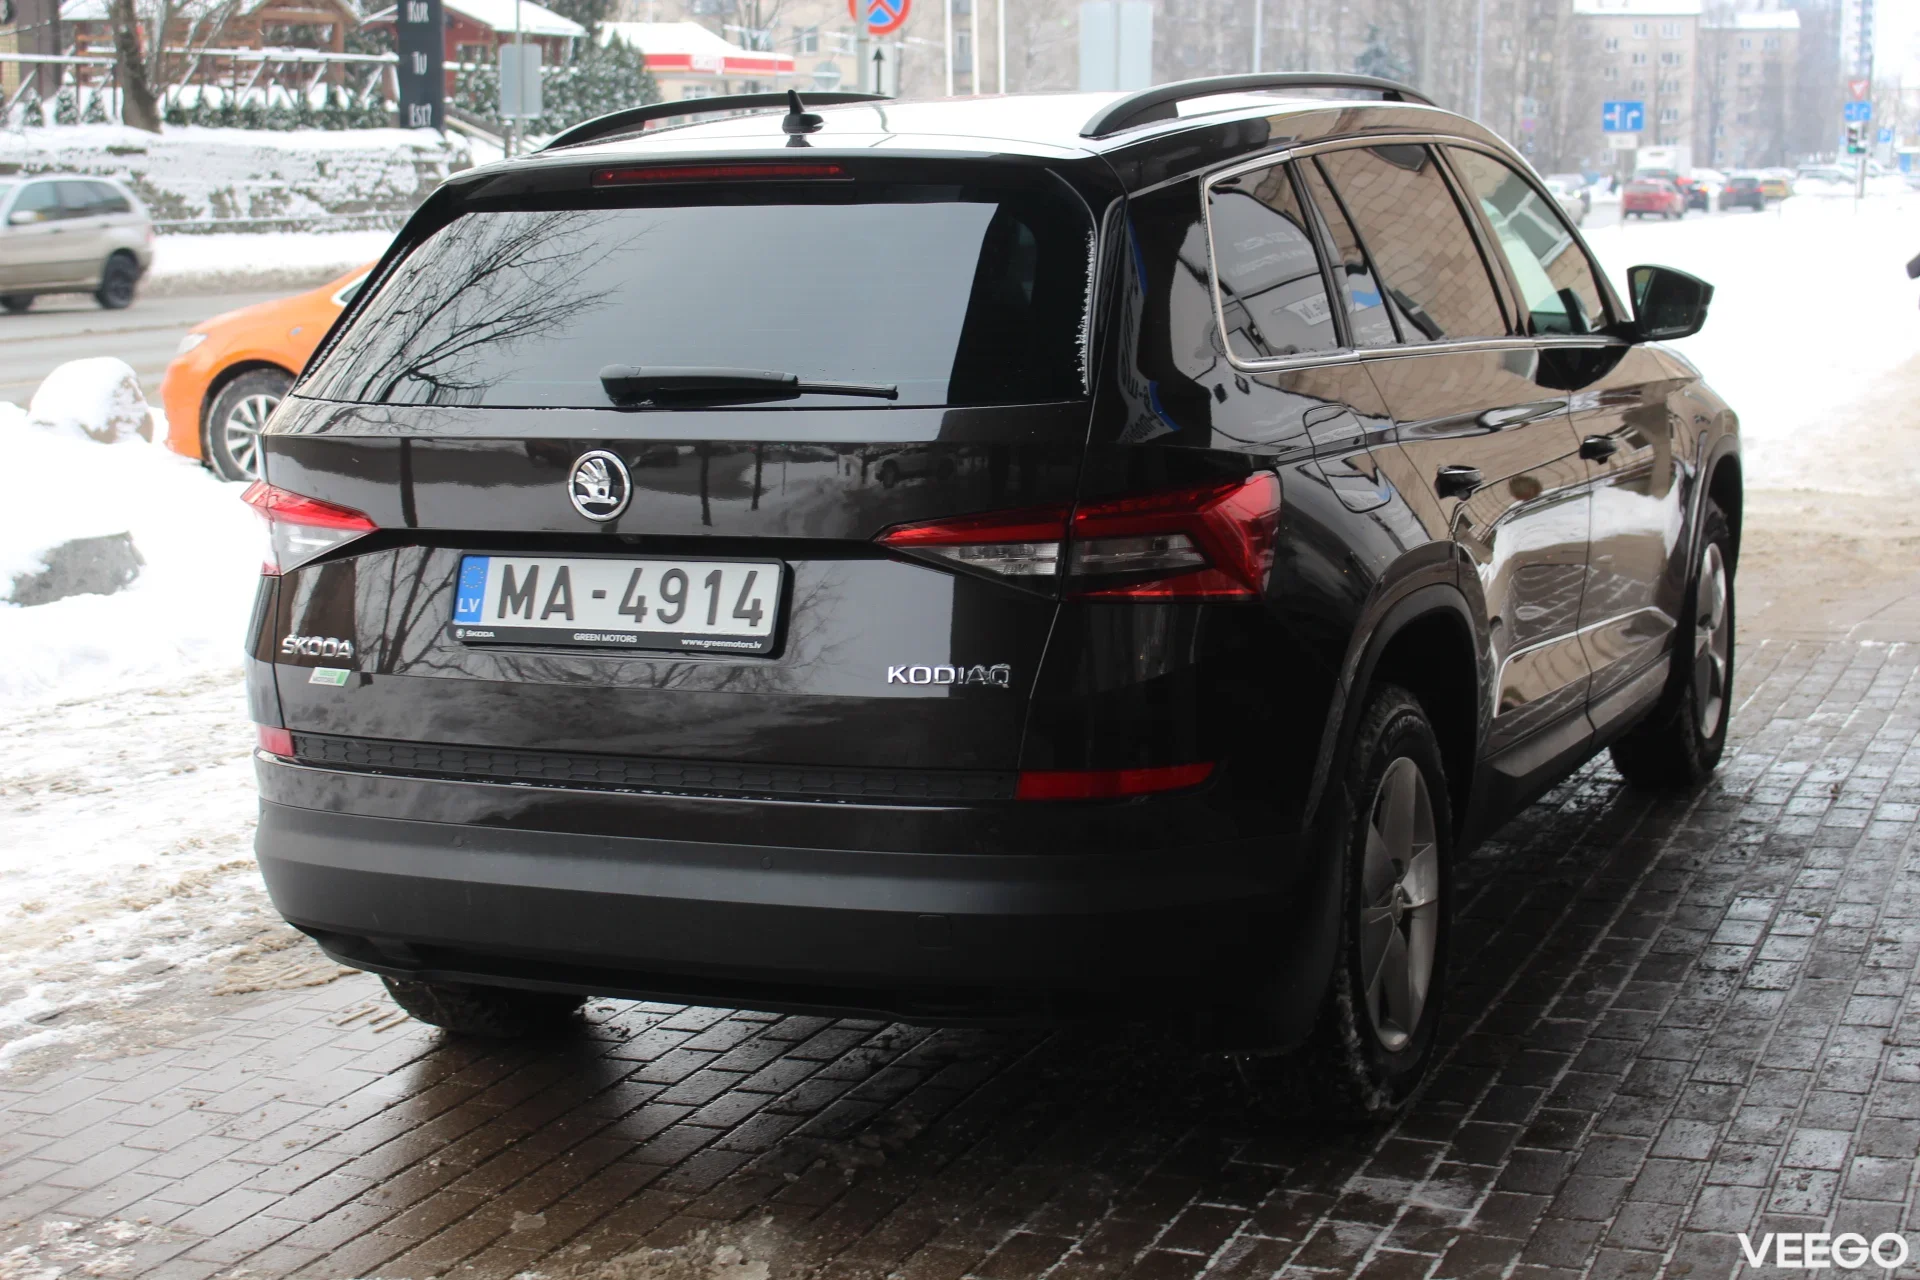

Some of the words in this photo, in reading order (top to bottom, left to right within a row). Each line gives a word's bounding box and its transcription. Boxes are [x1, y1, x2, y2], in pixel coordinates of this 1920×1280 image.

[411, 51, 428, 75] TU
[457, 597, 480, 614] LV
[497, 564, 764, 626] MA-4914
[281, 634, 354, 658] ŠKODA
[573, 633, 601, 642] GREEN
[602, 634, 638, 643] MOTORS
[681, 639, 762, 649] www.greenmotors.lv
[887, 664, 1010, 688] KODIAQ
